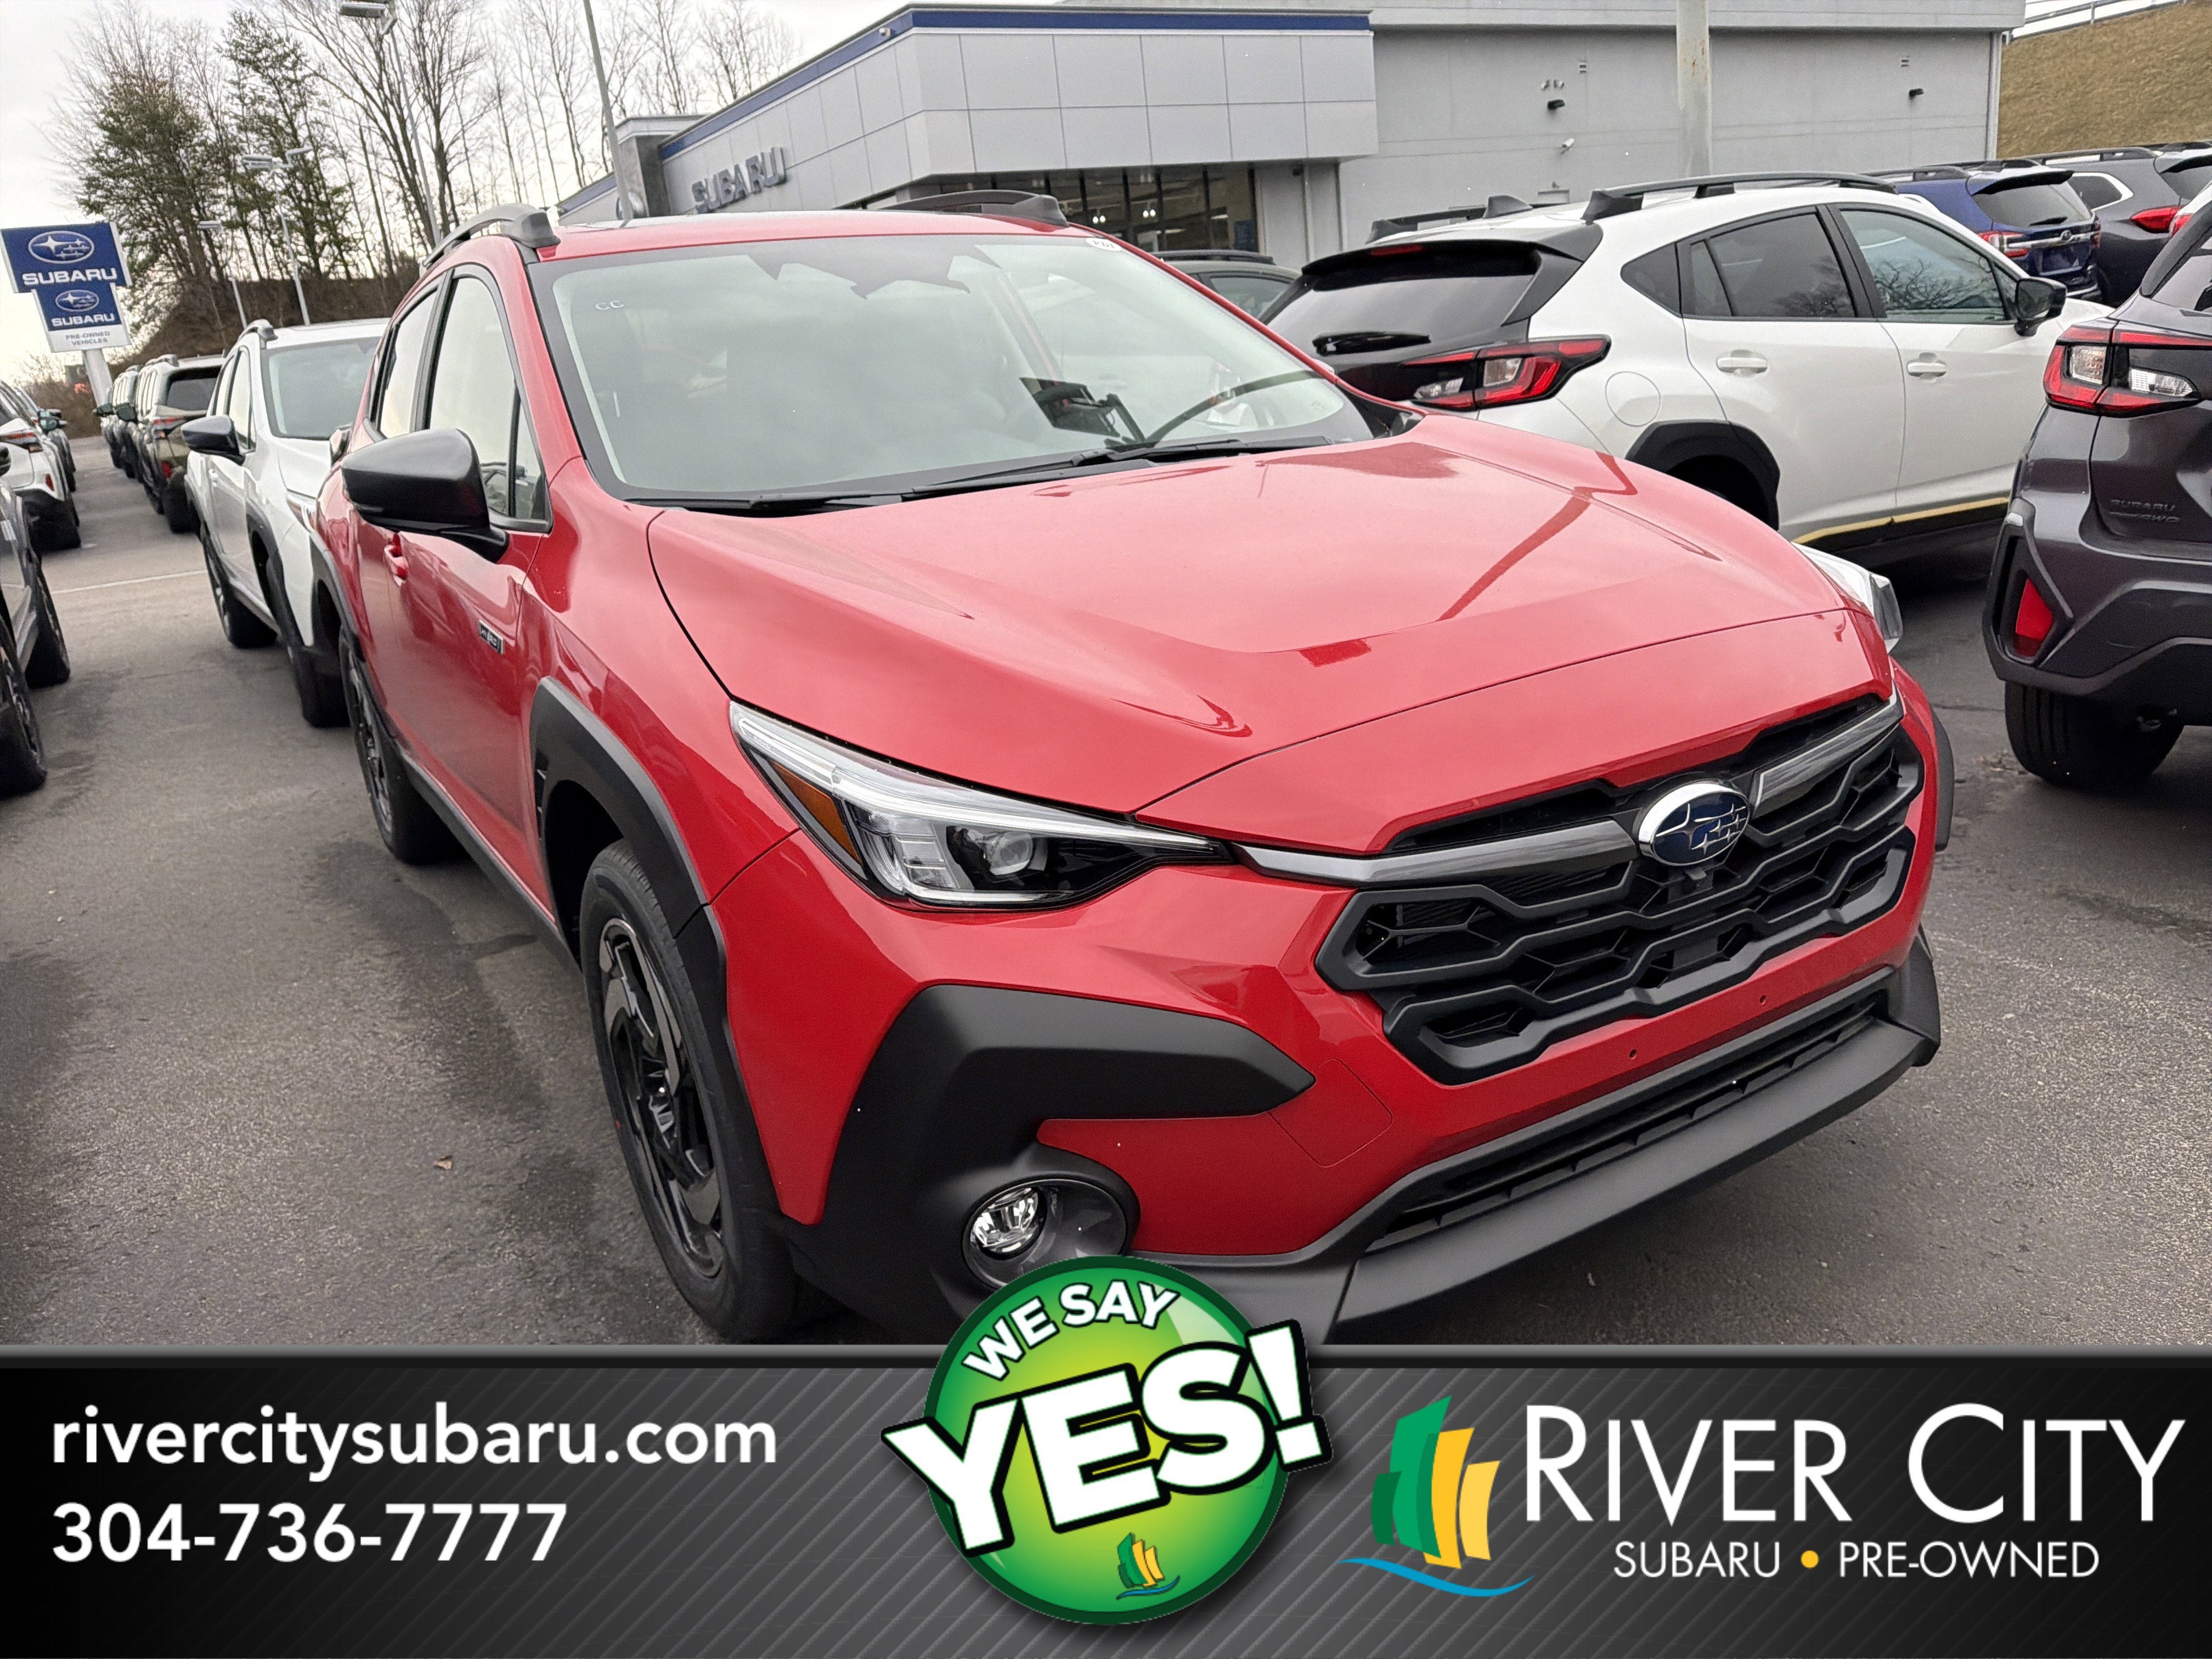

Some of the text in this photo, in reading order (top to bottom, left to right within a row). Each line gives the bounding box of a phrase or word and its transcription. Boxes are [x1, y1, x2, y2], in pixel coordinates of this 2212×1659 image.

[691, 146, 787, 214] SUBARU
[22, 268, 117, 286] SUBARU
[51, 313, 115, 327] SUBARU
[65, 331, 110, 340] PRE-OWNED
[72, 337, 108, 346] VEHICLES
